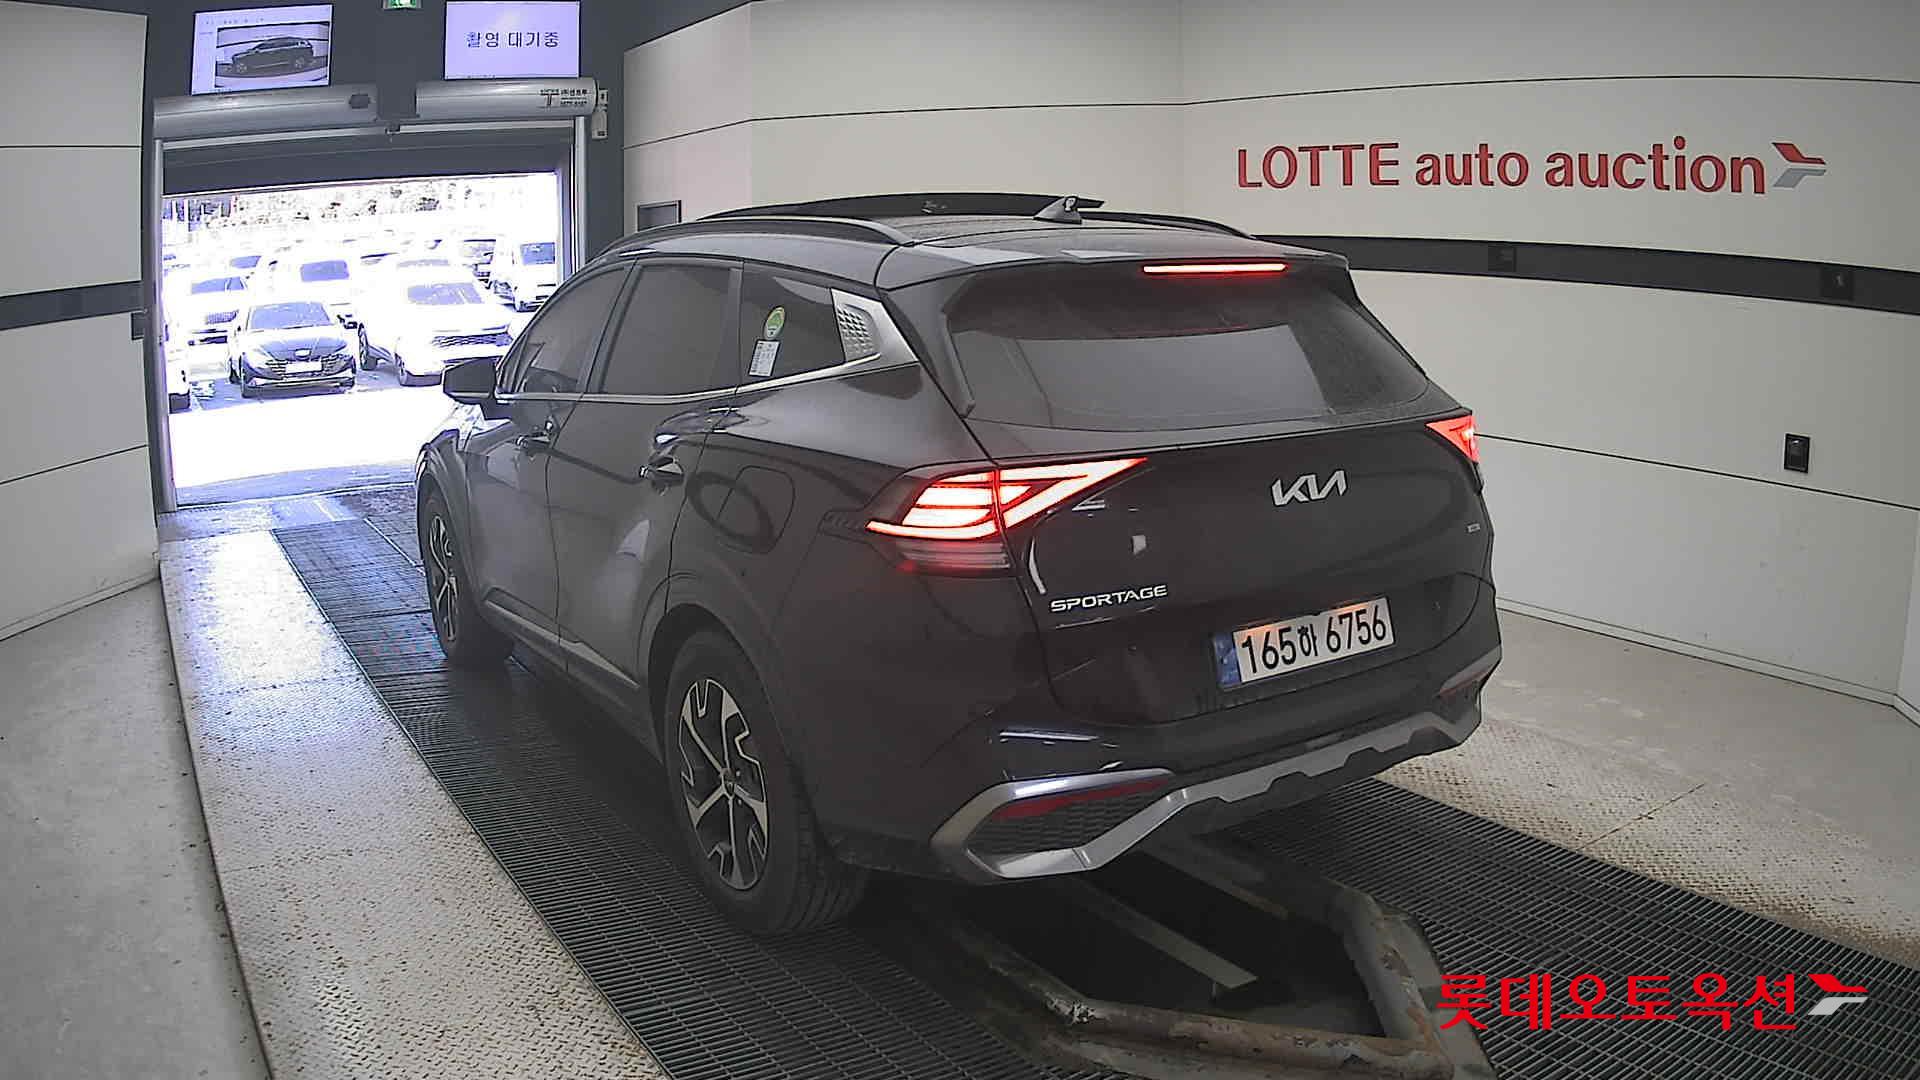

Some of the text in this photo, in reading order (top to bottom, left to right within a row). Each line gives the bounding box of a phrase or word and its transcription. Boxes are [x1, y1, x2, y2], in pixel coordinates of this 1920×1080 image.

[1237, 135, 1767, 194] LOTTE auto auction
[1271, 469, 1347, 506] KIA
[1050, 584, 1168, 612] SPORTAGE
[1325, 604, 1387, 653] 6756
